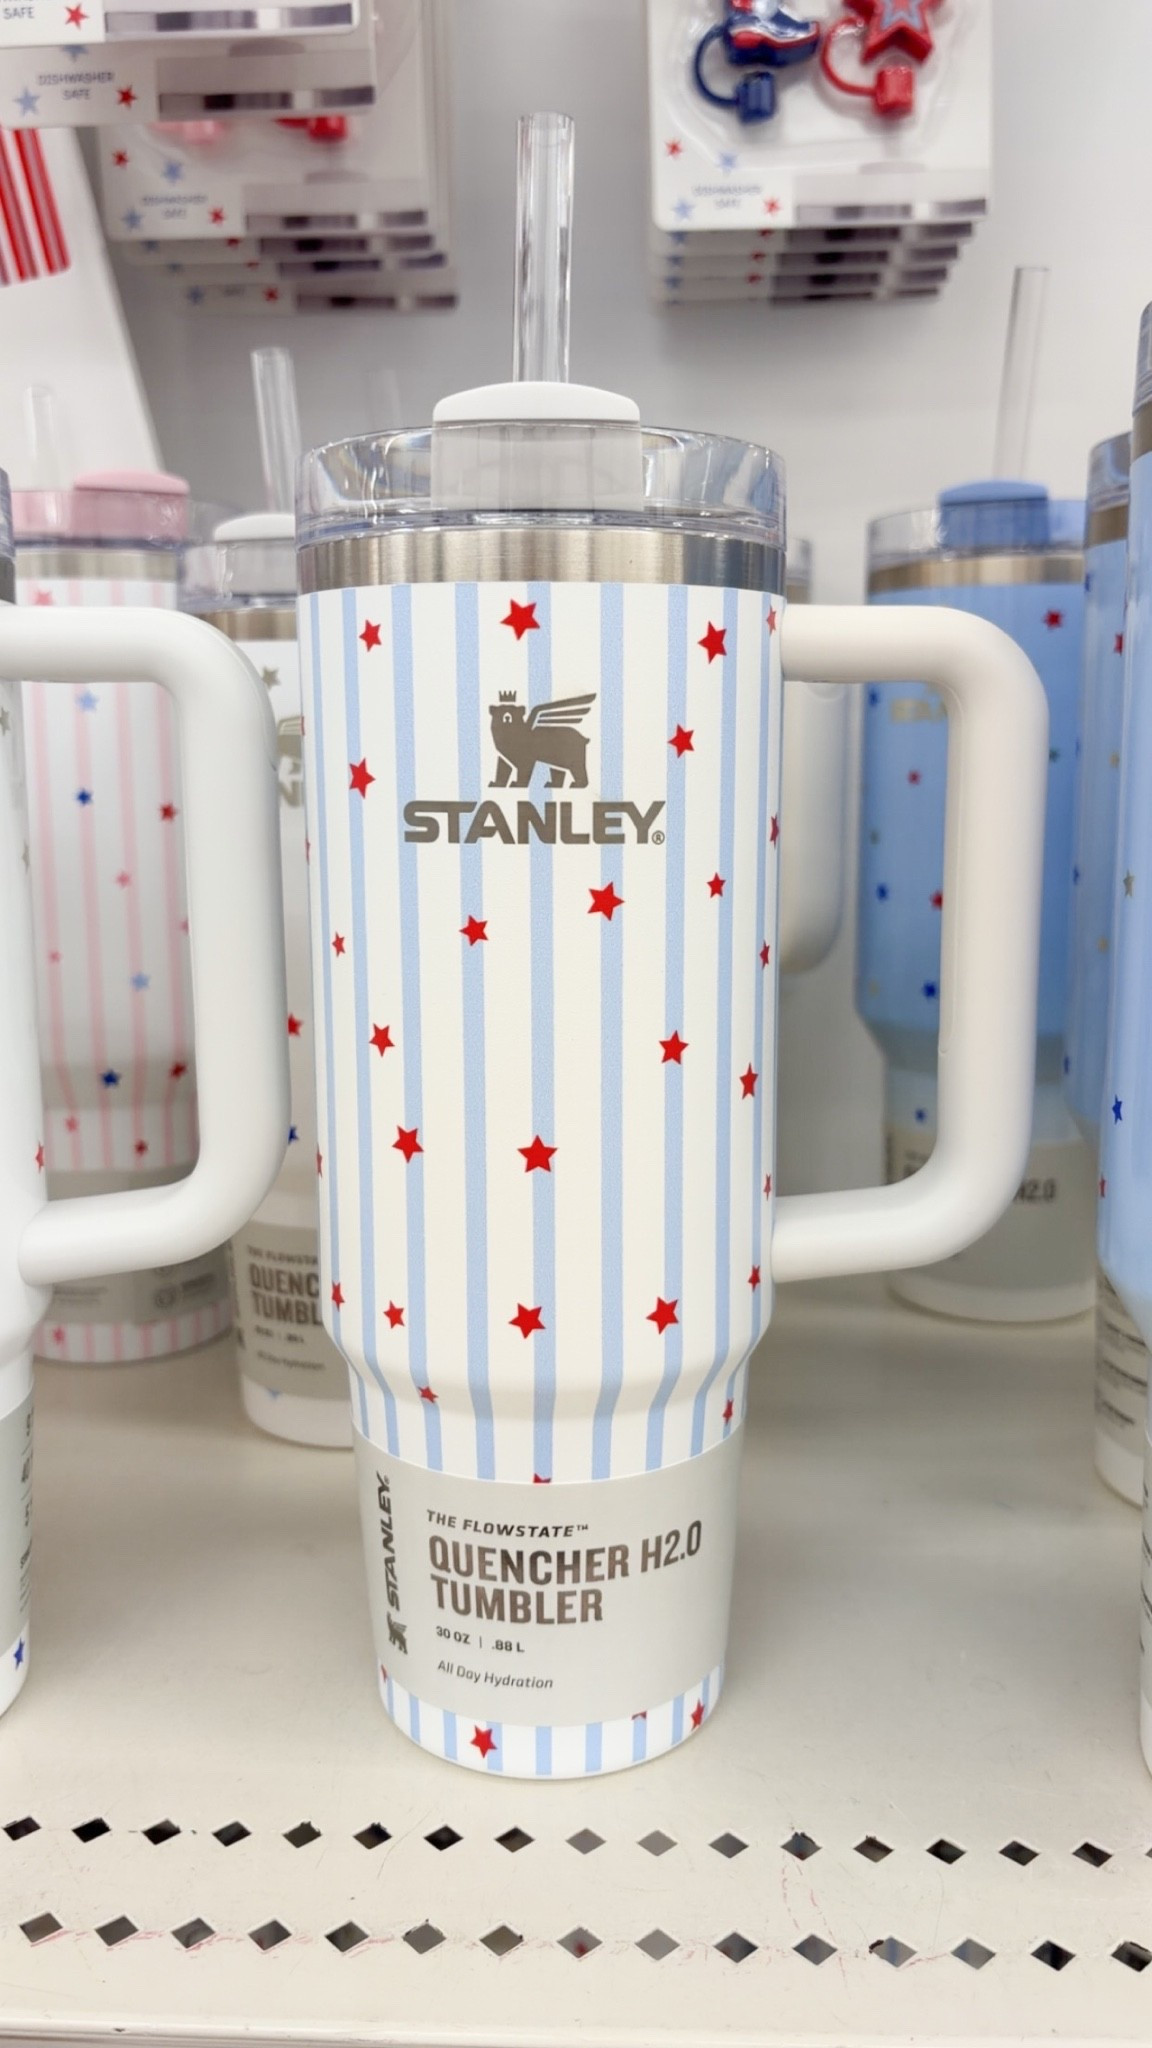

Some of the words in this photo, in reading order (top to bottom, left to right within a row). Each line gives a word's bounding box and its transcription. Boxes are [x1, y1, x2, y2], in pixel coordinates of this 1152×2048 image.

[3, 6, 34, 20] SAFE
[426, 1508, 457, 1528] THE
[429, 1534, 630, 1586] QUENCHER
[640, 1519, 702, 1574] H2.0
[430, 1573, 603, 1625] TUMBLER
[436, 1625, 451, 1640] 30
[453, 1631, 471, 1645] OZ
[492, 1639, 513, 1652] .88
[516, 1641, 525, 1653] L
[437, 1660, 454, 1675] All
[456, 1665, 482, 1684] Day
[483, 1671, 554, 1689] Hydration
